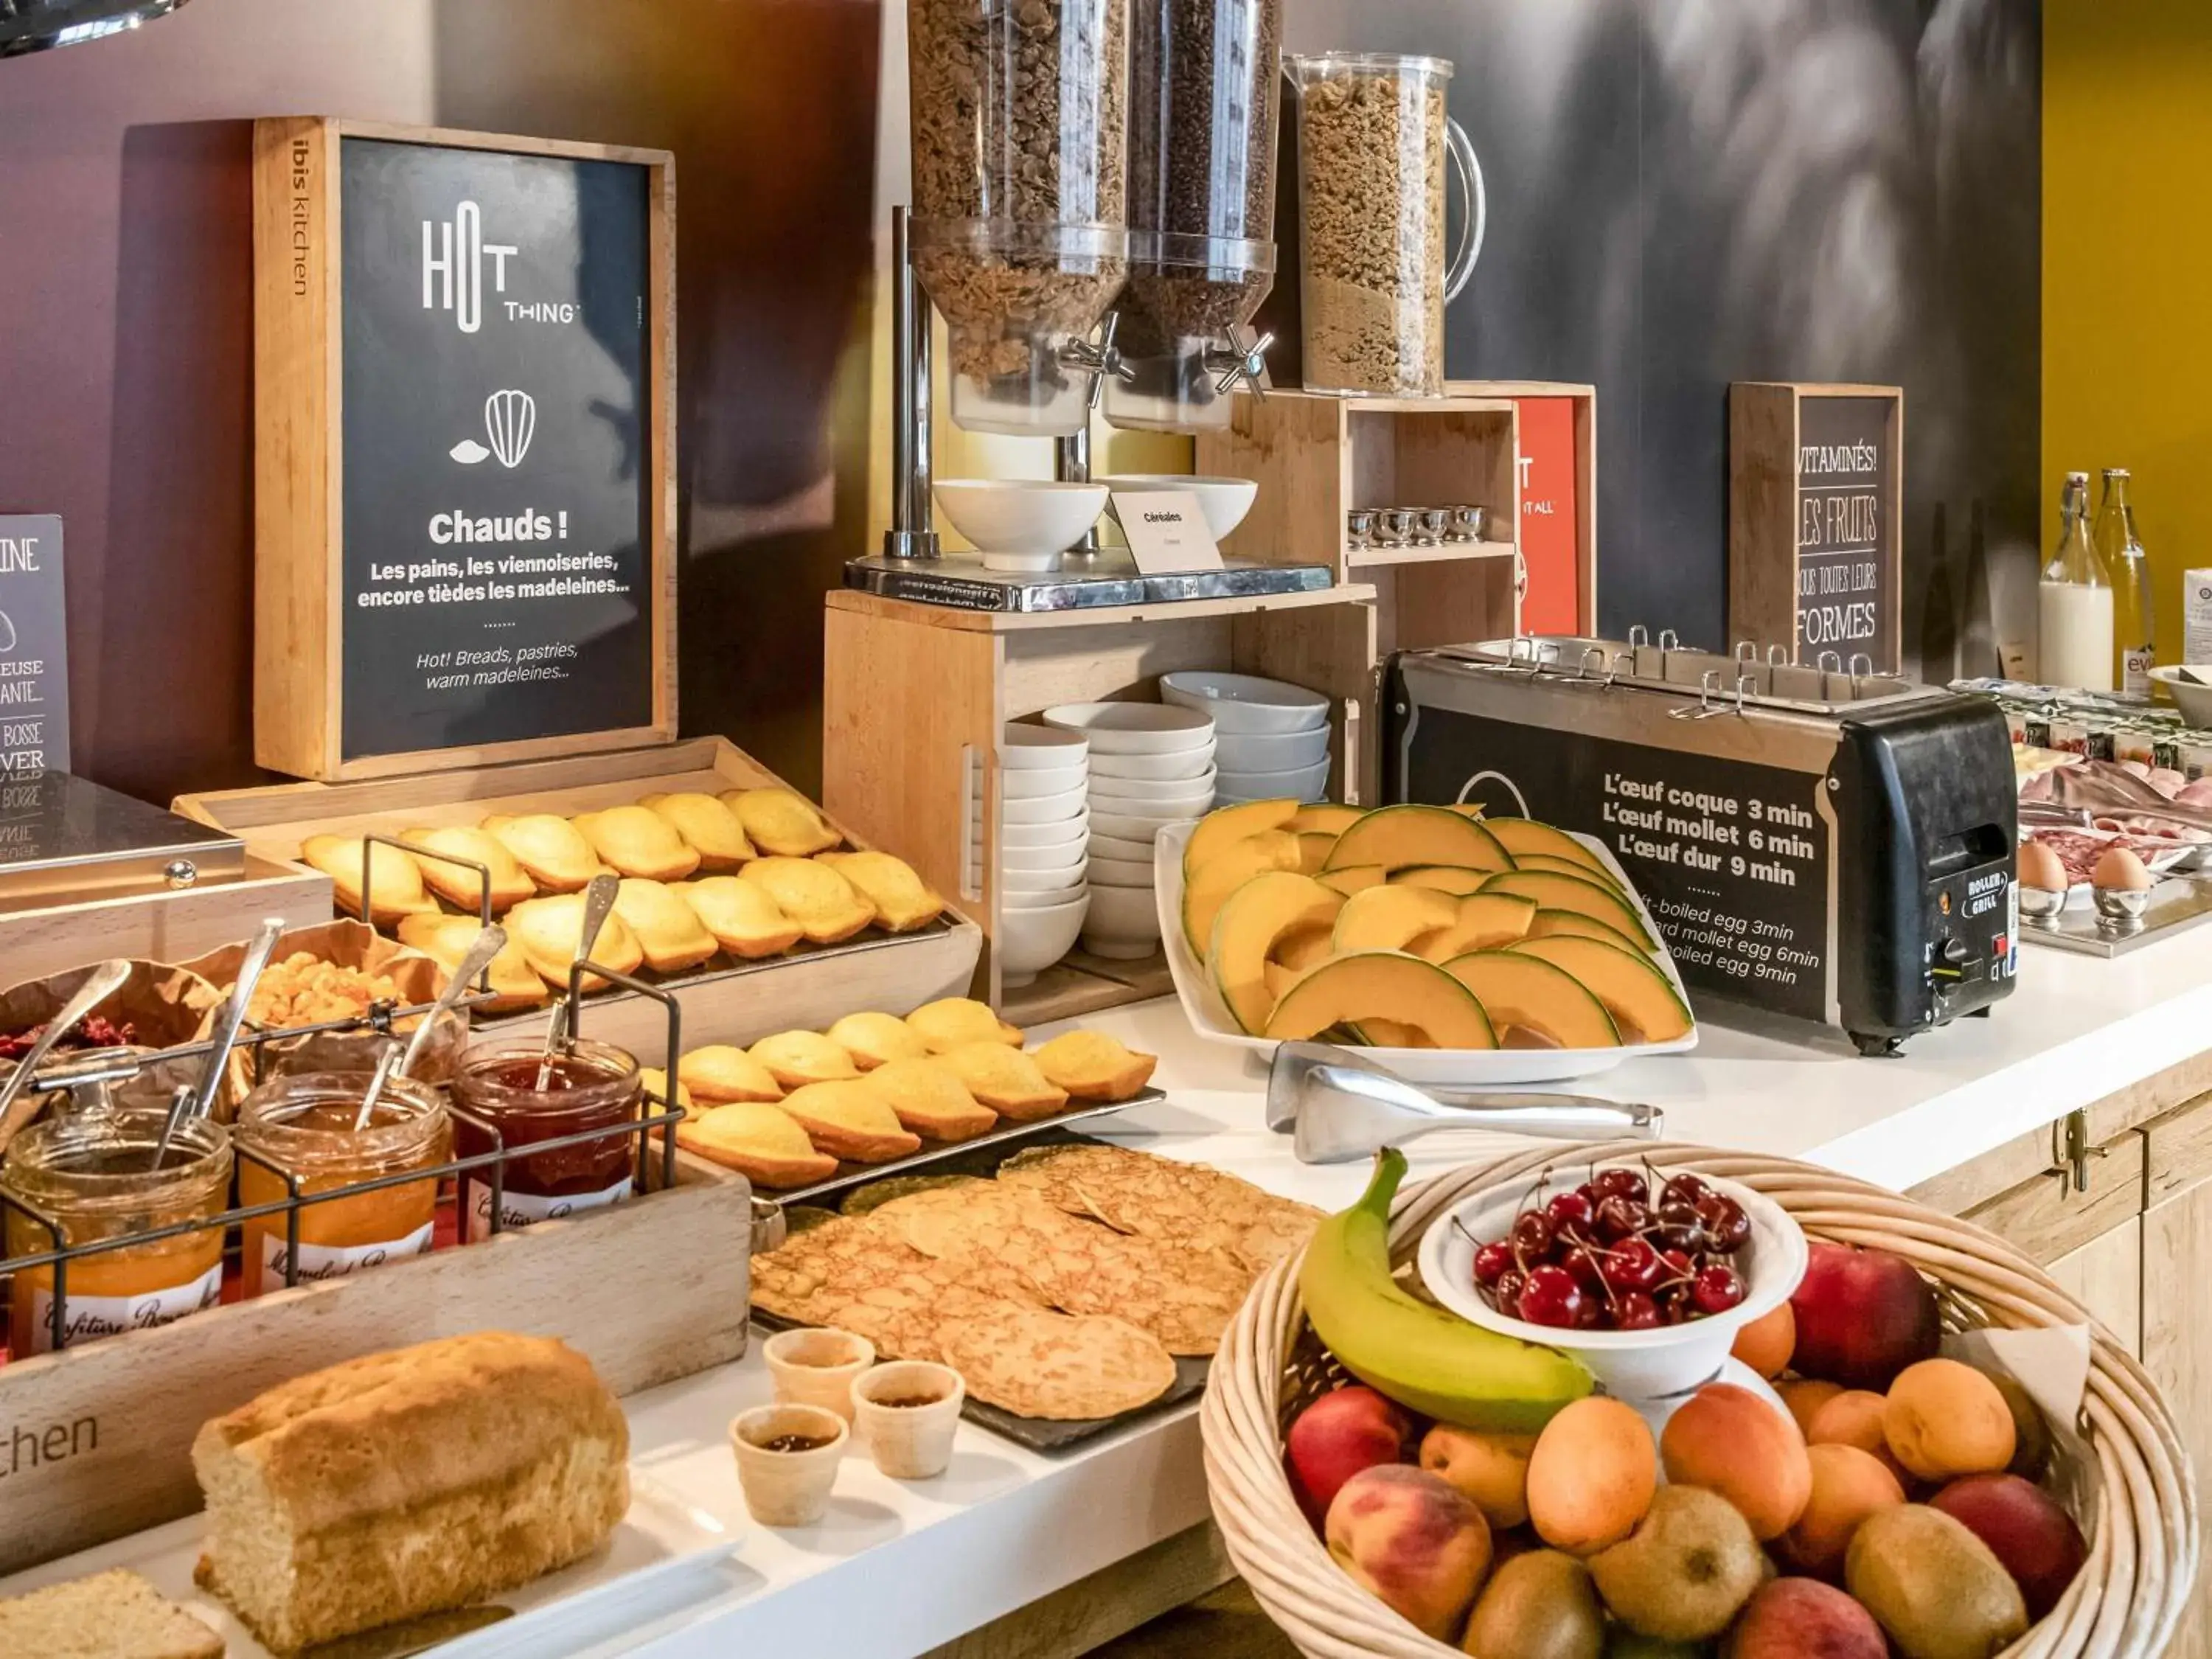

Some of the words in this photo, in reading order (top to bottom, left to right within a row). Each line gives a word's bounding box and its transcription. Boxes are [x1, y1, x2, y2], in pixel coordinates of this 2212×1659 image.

[293, 140, 309, 189] ibis
[293, 198, 310, 296] kitchen
[422, 200, 518, 333] HOT
[428, 508, 552, 544] Chauds
[1826, 495, 1877, 544] FRUITS
[371, 563, 405, 581] Les
[408, 558, 465, 582] pains,
[467, 557, 494, 577] les
[497, 551, 619, 574] viennoiseries,
[1819, 565, 1849, 595] TOUTES
[1851, 563, 1877, 591] LEURS
[358, 588, 425, 608] encore
[428, 582, 485, 603] tièdes
[488, 581, 515, 599] les
[416, 652, 451, 669] Hot!
[455, 646, 513, 667] Breads,
[516, 641, 578, 664] pastries,
[426, 673, 469, 689] warm
[4, 722, 44, 747] BOSSE
[1604, 773, 1664, 802] L'œuf
[1668, 789, 1738, 815] coque
[1747, 799, 1763, 819] 3
[1767, 804, 1813, 829] min
[1603, 802, 1663, 831] L'œuf
[1666, 816, 1739, 846] mollet
[1748, 830, 1764, 849] 6
[1769, 835, 1814, 859] min
[1618, 834, 1679, 863] L'œuf
[1683, 846, 1722, 872] dur
[1731, 856, 1746, 876] 9
[1750, 861, 1795, 886] min
[1714, 914, 1747, 935] egg
[1752, 920, 1794, 941] 3min
[1682, 928, 1733, 950] mollet
[1738, 941, 1771, 961] egg
[1776, 947, 1819, 968] 6min
[1717, 957, 1750, 977] egg
[1754, 964, 1797, 985] 9min
